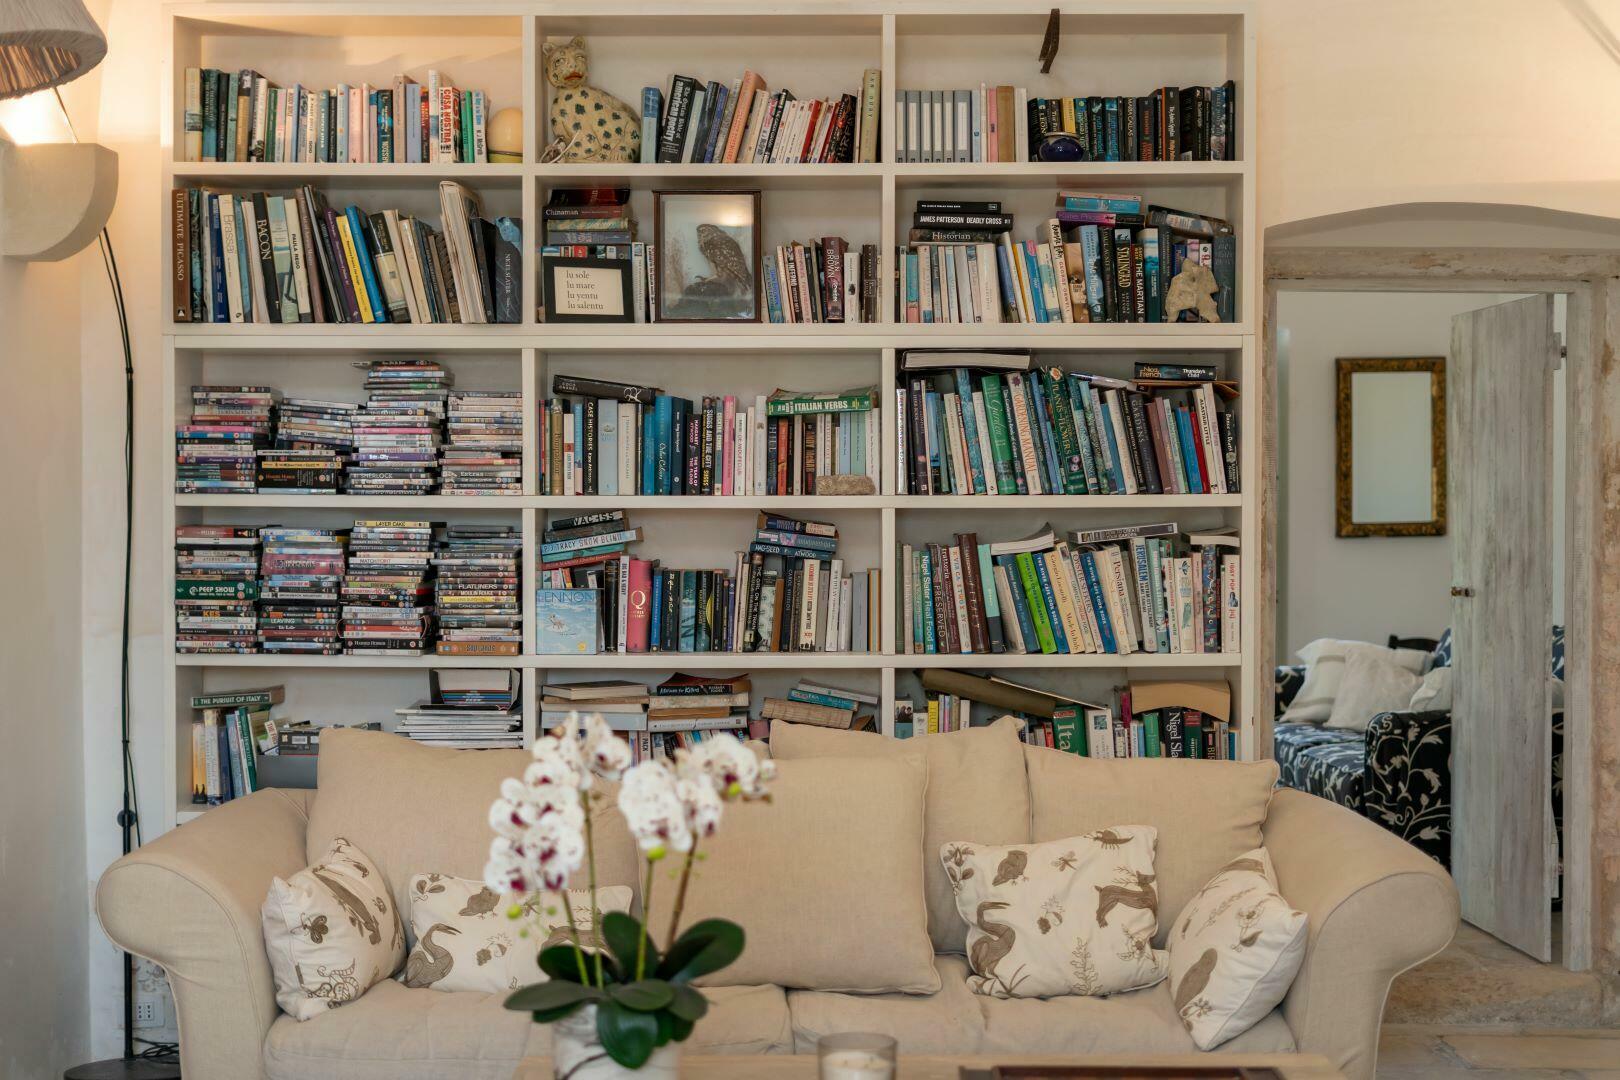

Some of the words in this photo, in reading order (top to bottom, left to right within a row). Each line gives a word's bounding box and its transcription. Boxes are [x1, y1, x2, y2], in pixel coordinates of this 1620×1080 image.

[444, 89, 452, 110] COSA
[670, 81, 684, 116] american
[444, 112, 452, 143] NOSTRA
[663, 116, 678, 142] poetry
[257, 219, 272, 260] BACON
[932, 232, 971, 240] Historian
[575, 270, 590, 278] sole
[788, 262, 797, 287] INFERNO
[1117, 247, 1131, 288] STALINGRAD
[577, 301, 604, 310] salentu
[794, 402, 822, 411] ITALIAN
[824, 400, 848, 410] VERBS
[1052, 384, 1063, 413] PLANTS
[1058, 417, 1070, 455] FLOWERS
[1132, 400, 1144, 443] GARDENS
[769, 426, 777, 453] HILL
[806, 431, 815, 448] ANDY
[1014, 394, 1030, 437] GARDENING
[1024, 438, 1037, 474] MANUAL
[556, 541, 576, 551] TRACY
[579, 537, 600, 547] SNOW
[755, 544, 780, 553] HAG-SEED
[921, 556, 929, 574] Nigel
[942, 548, 950, 579] trattoria
[1136, 545, 1148, 582] JERUSALEM
[1073, 554, 1084, 582] OYSTER
[1081, 583, 1092, 613] SEEKERS
[1113, 561, 1126, 597] Persiana
[631, 591, 646, 609] Q
[934, 585, 945, 637] PRESERVED
[1058, 722, 1075, 750] Ita
[1166, 711, 1180, 740] Nigel
[1170, 742, 1182, 758] Sla
